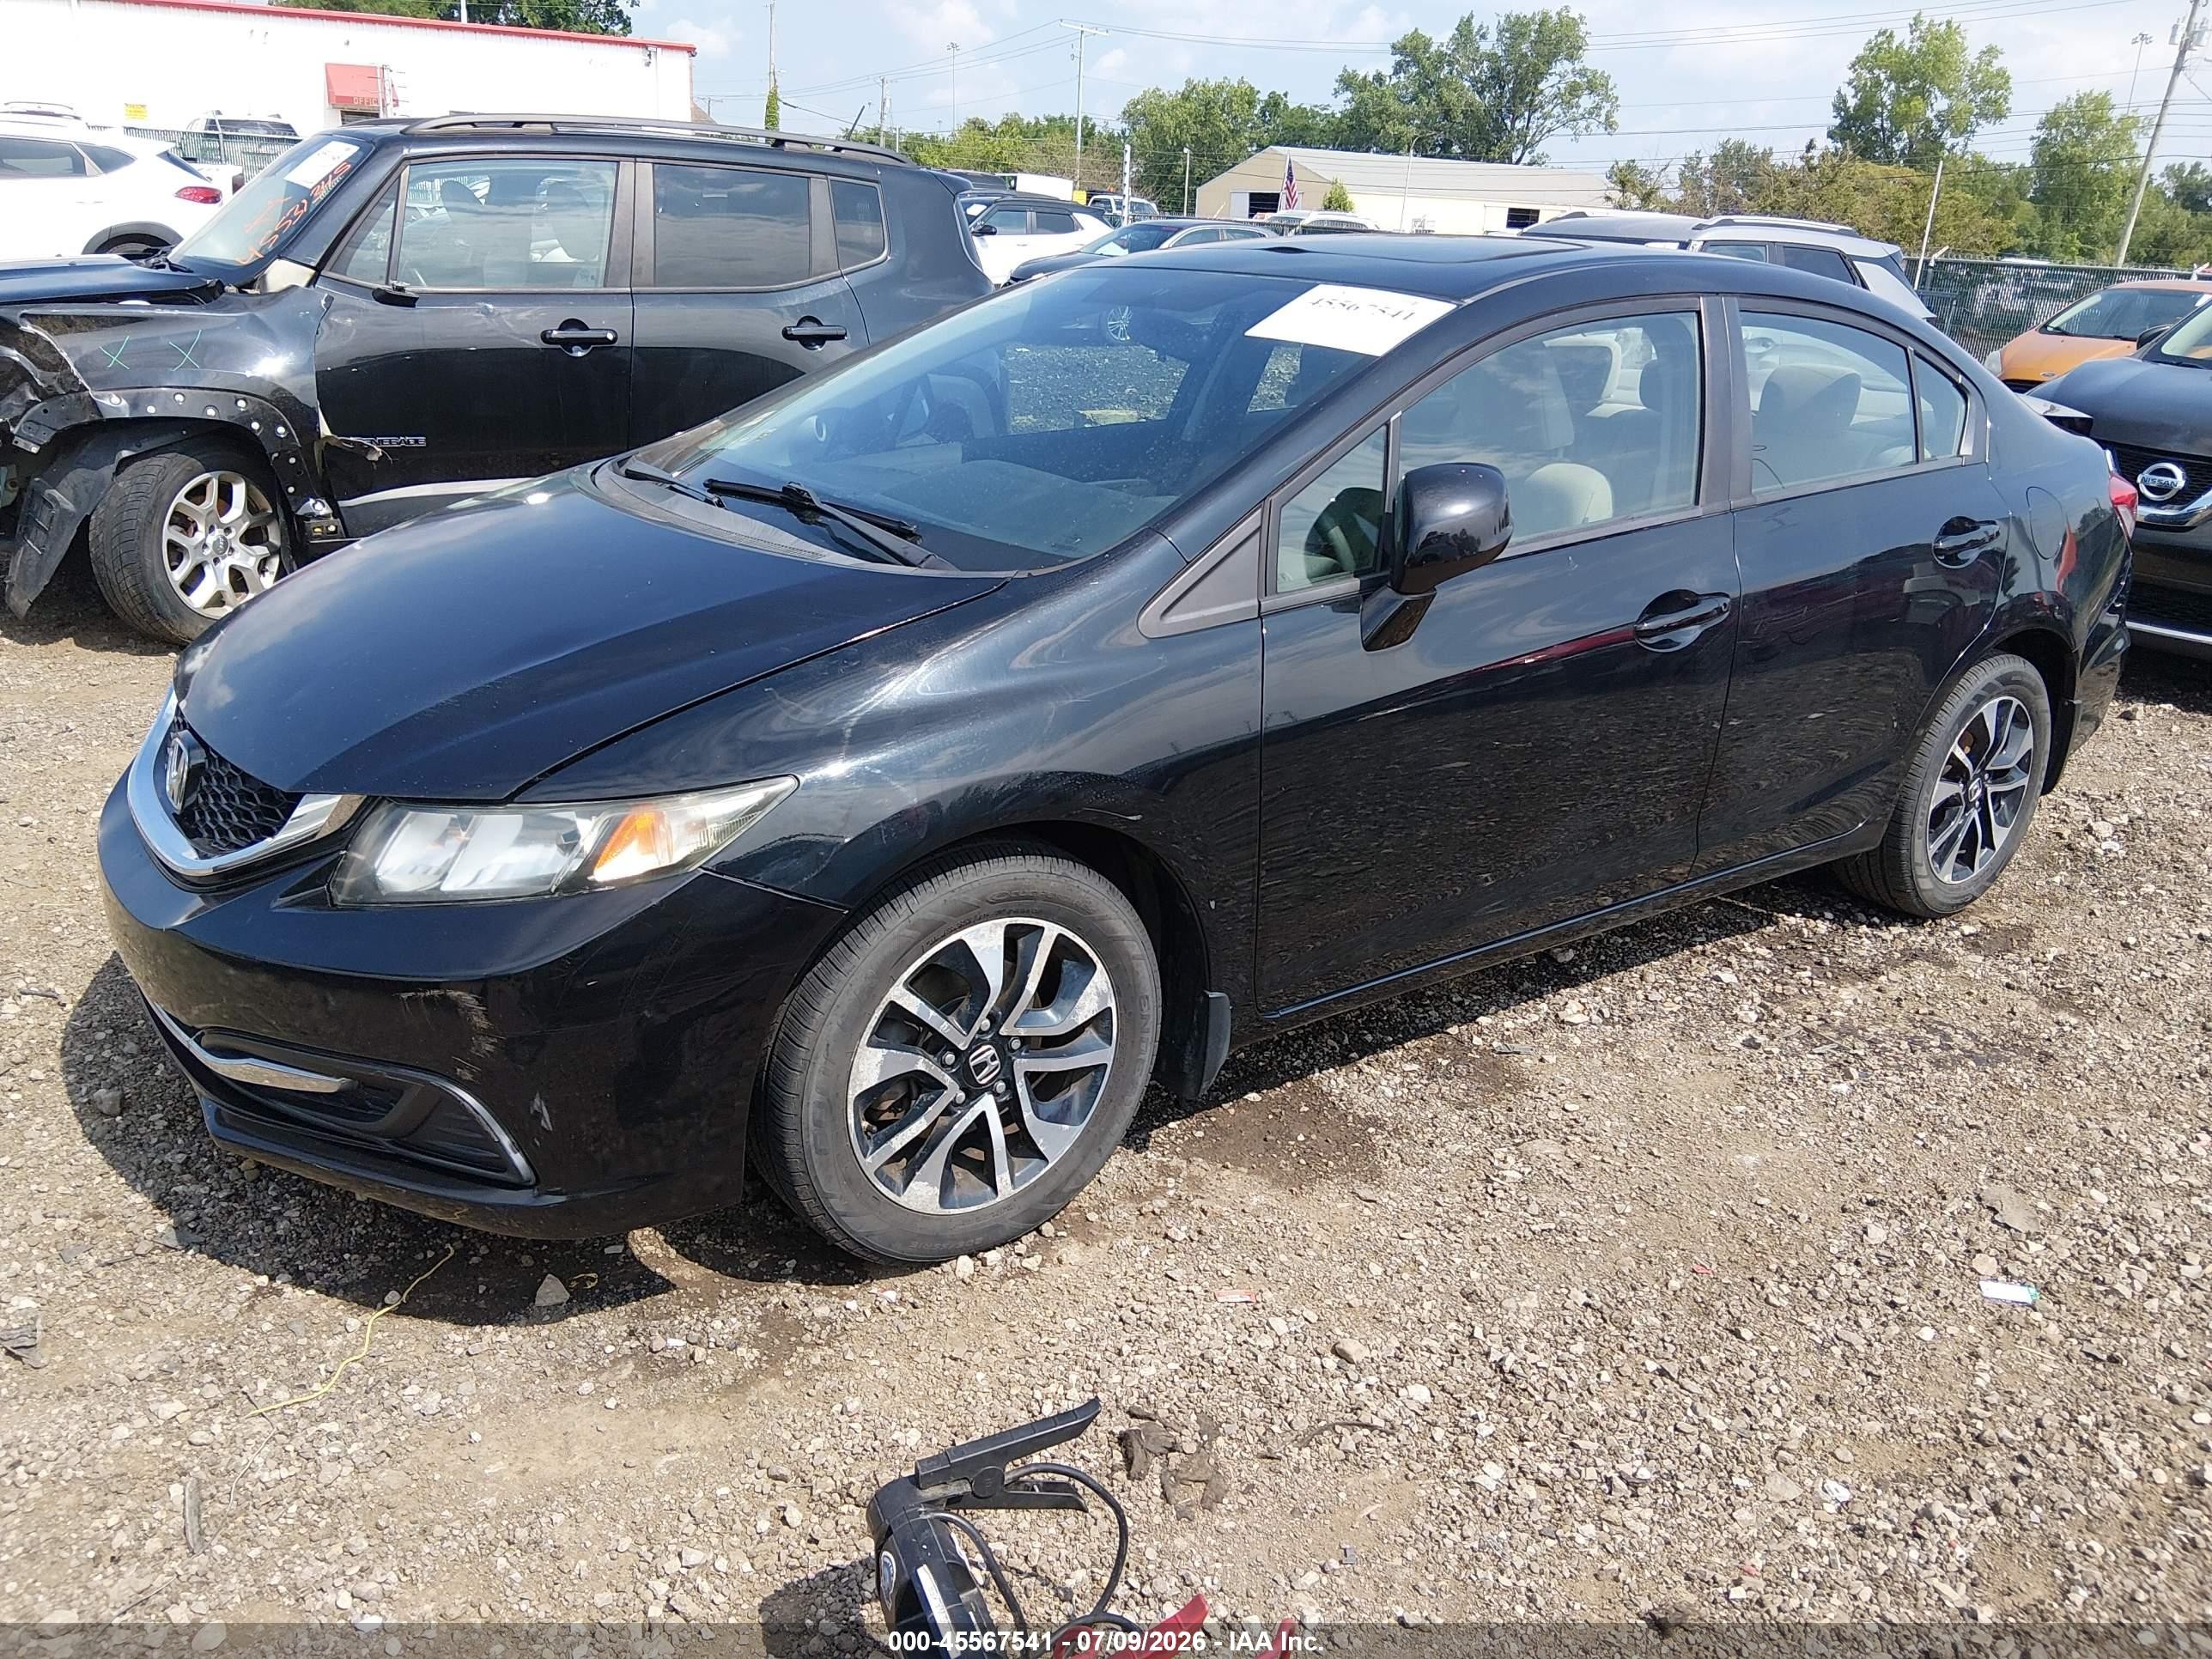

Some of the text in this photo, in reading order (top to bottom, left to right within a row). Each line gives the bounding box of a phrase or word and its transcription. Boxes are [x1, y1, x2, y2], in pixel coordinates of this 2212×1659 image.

[353, 96, 380, 106] OFFIC
[357, 436, 427, 447] ENEGADE
[2140, 475, 2179, 488] NISSAN
